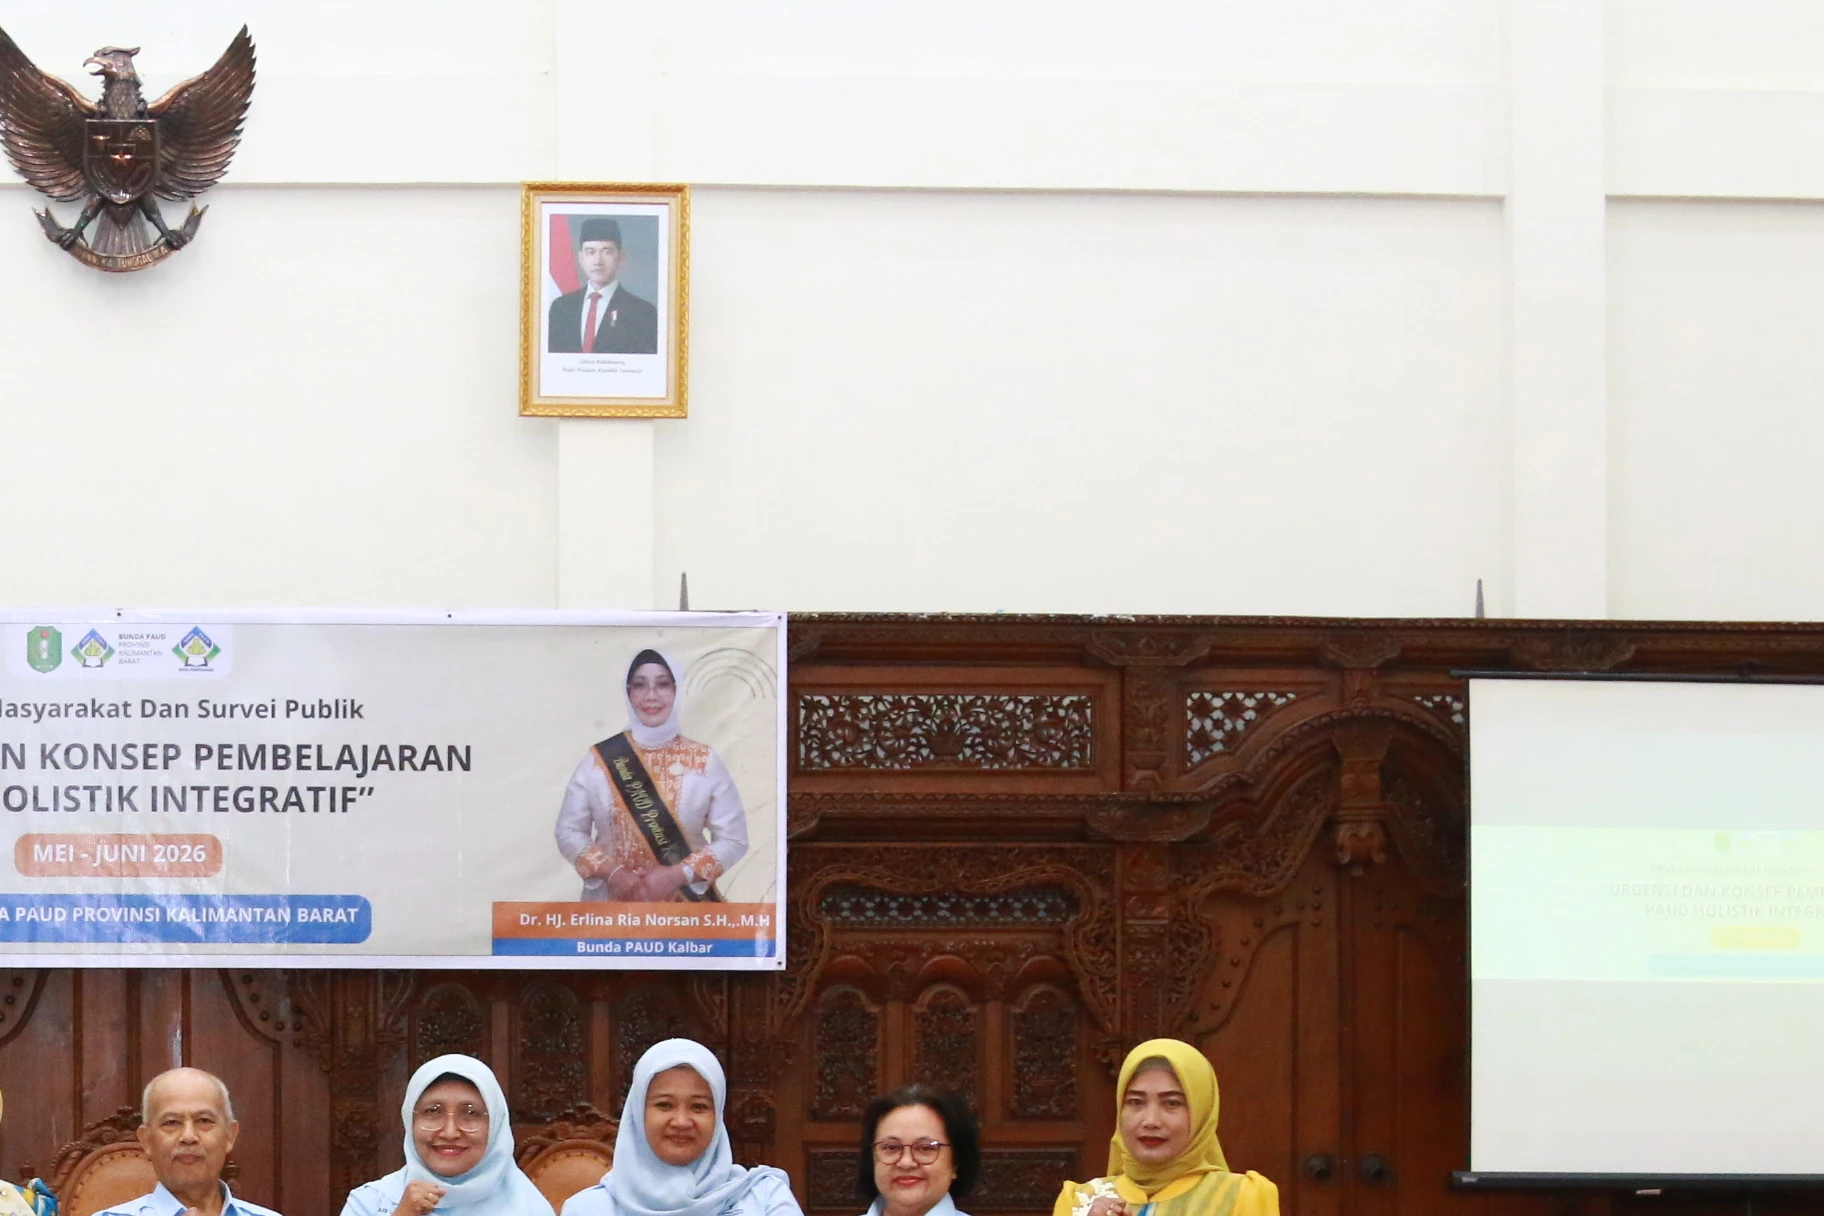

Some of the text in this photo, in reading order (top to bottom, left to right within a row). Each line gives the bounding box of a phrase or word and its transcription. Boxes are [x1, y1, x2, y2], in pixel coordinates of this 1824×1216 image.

[140, 699, 189, 718] Dan
[197, 699, 276, 719] Survei
[285, 699, 364, 719] Publik
[41, 743, 182, 771] KONSEP
[194, 743, 472, 778] PEMBELAJARAN
[151, 785, 375, 813] INTEGRATIF”
[33, 844, 74, 862] MEI
[92, 844, 146, 867] JUNI
[153, 844, 207, 863] 2026
[1682, 884, 1716, 898] DAN
[1721, 884, 1780, 899] KONSEP
[15, 907, 67, 922] PAUD
[73, 907, 160, 923] PROVINSI
[166, 907, 292, 923] KALIMANTAN
[297, 907, 359, 923] BARAT
[1645, 903, 1689, 917] PAUD
[1694, 904, 1763, 918] HOLISTIK
[519, 913, 541, 926] Dr.
[546, 914, 566, 928] HJ.
[570, 913, 613, 926] Erlina
[617, 913, 641, 926] Ria
[645, 914, 700, 927] Norsan
[577, 940, 714, 953] Bunda PAUD Kalbar
